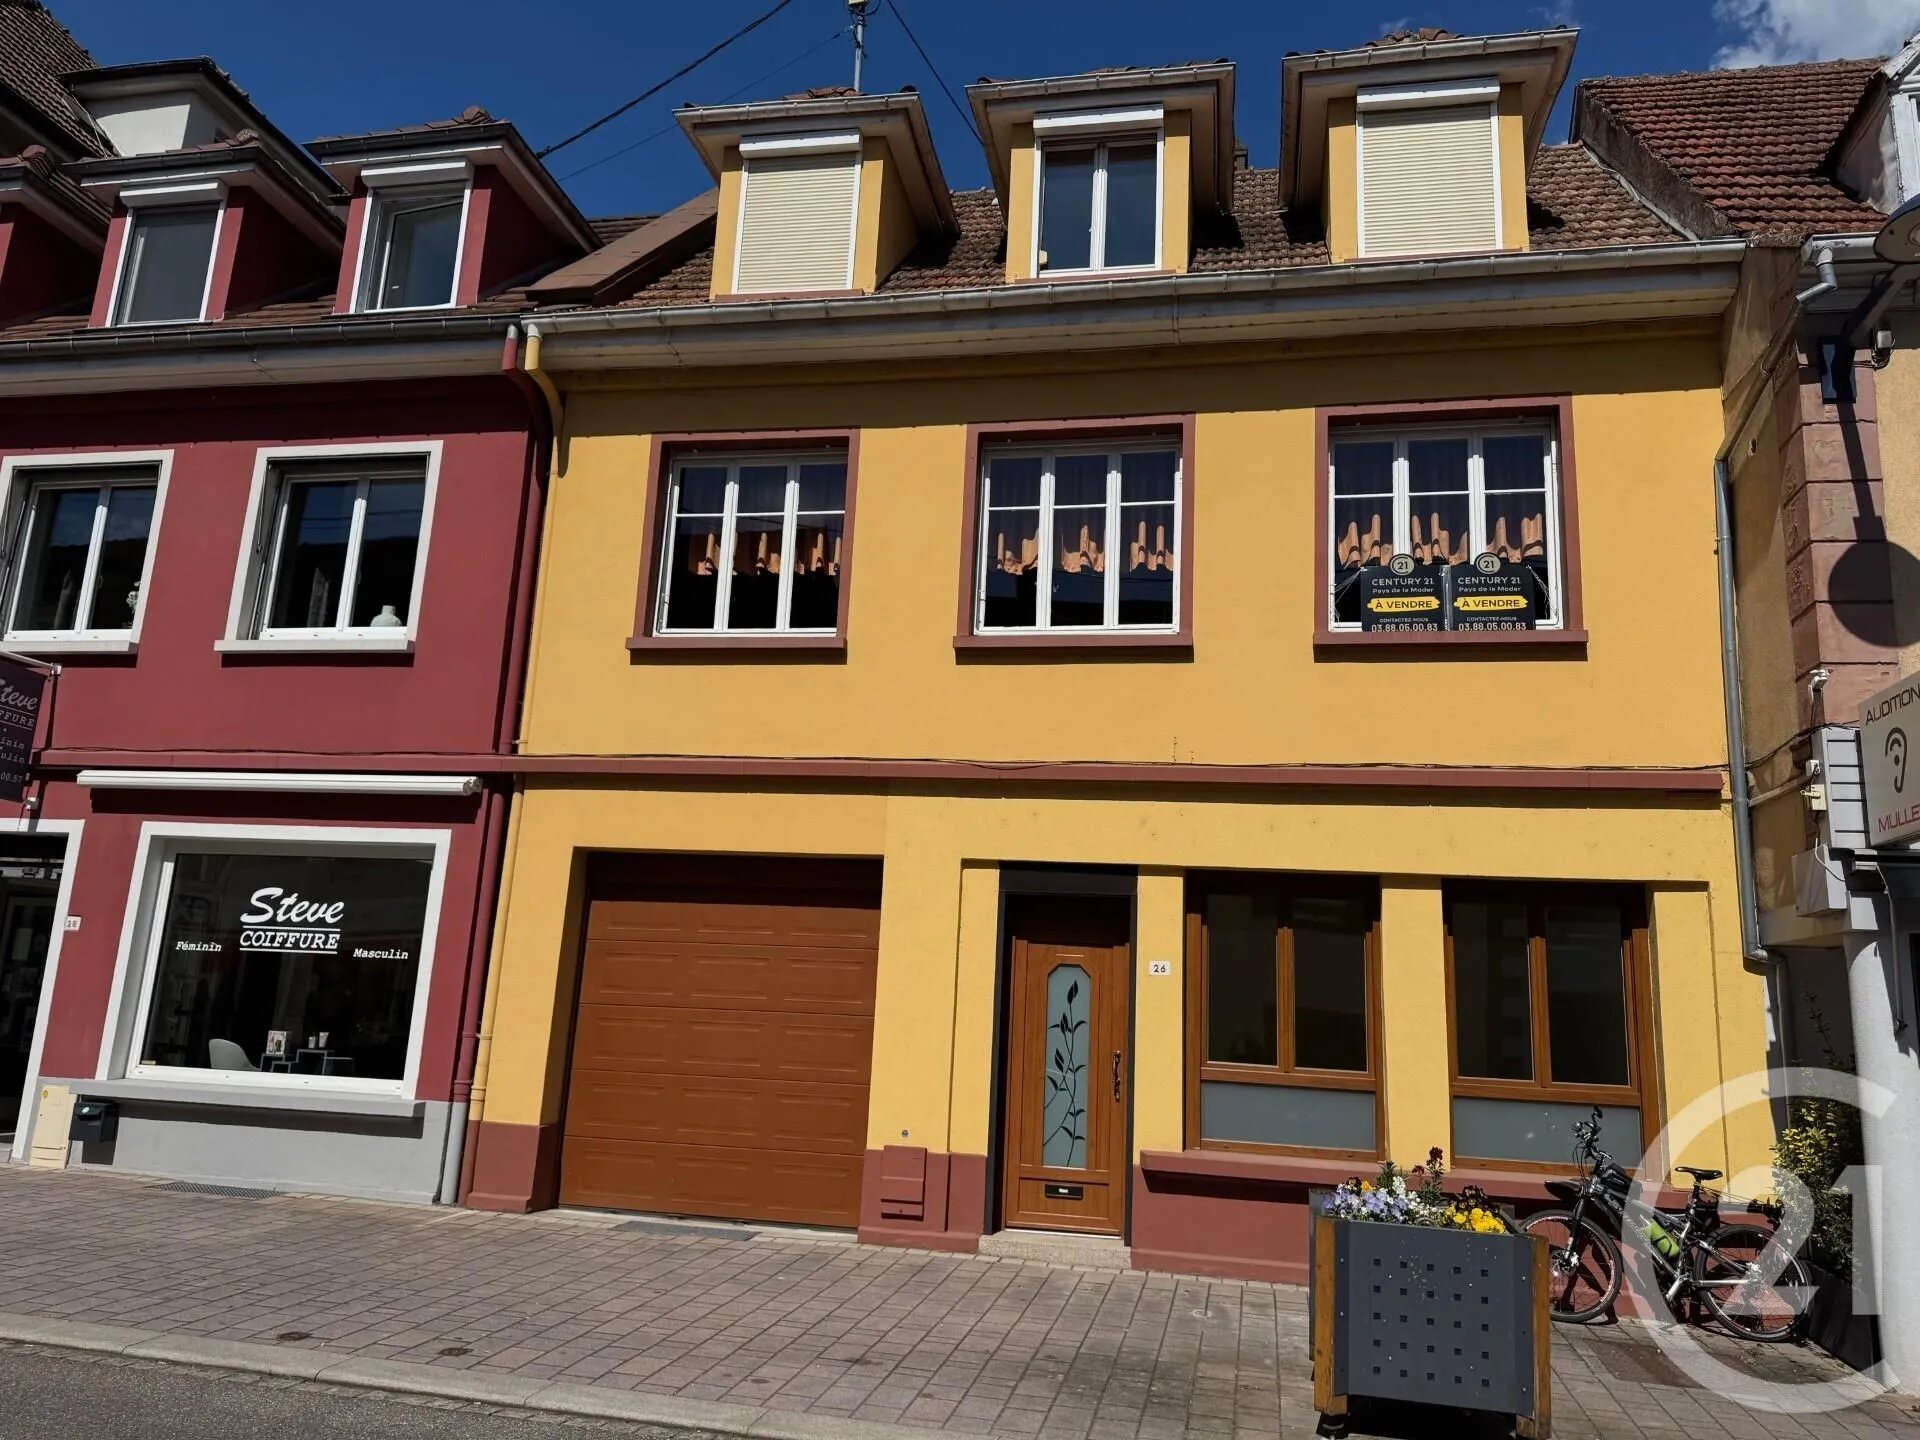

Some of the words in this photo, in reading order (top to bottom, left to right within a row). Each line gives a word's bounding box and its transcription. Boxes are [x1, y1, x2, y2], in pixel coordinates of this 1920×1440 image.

[1371, 577, 1421, 586] CENTURY
[1423, 577, 1435, 585] 21
[1457, 576, 1508, 585] CENTURY
[1511, 576, 1521, 584] 21
[1375, 599, 1383, 609] À
[1386, 600, 1433, 609] VENDRE
[1462, 598, 1470, 608] À
[1473, 599, 1520, 608] VENDRE
[1458, 622, 1527, 632] 03.88.05.00.83
[0, 678, 38, 710] teve
[1865, 682, 1920, 726] AUDITION
[240, 887, 345, 923] Steve
[239, 930, 340, 950] COIFFURE
[176, 941, 222, 952] Féminin
[353, 948, 409, 960] Masculin
[1153, 964, 1166, 973] 26
